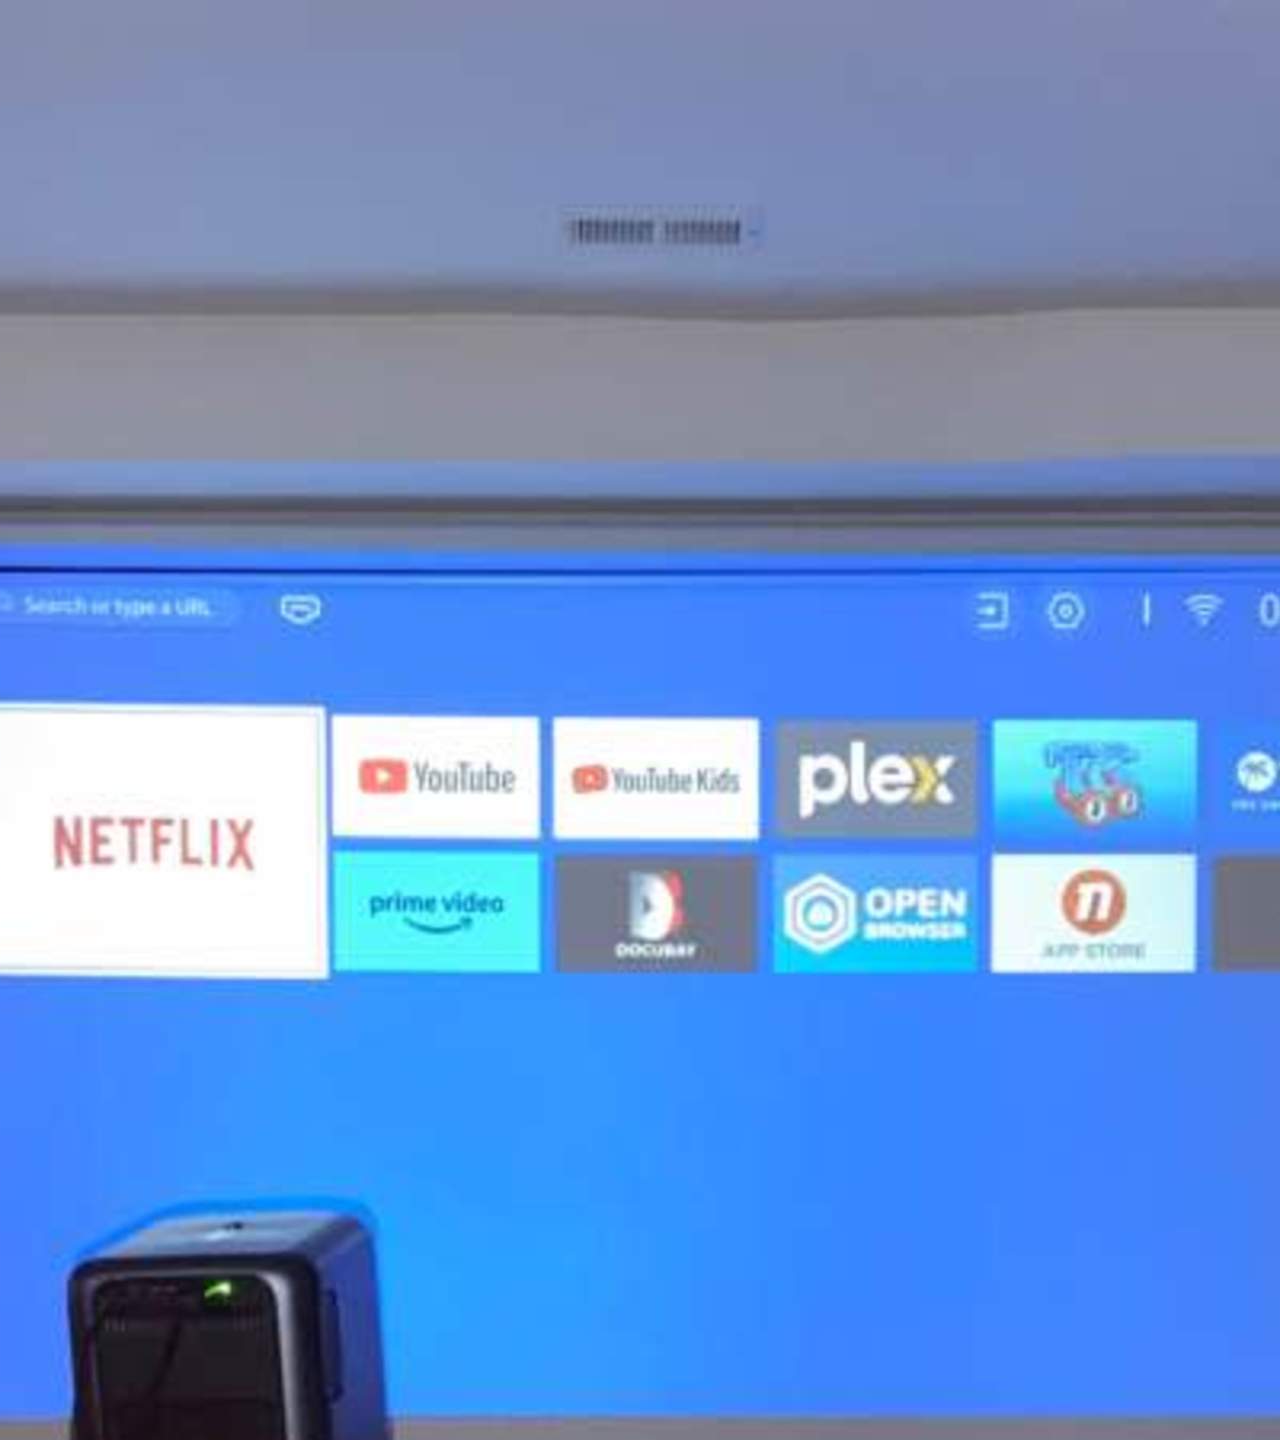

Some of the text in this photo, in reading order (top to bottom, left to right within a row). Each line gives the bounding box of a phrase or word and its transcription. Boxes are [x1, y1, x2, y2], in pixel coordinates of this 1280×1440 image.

[24, 595, 84, 617] Search
[114, 598, 154, 620] type
[176, 597, 211, 617] URL
[414, 762, 517, 794] YouTube
[613, 767, 741, 793] YouTube Kids
[798, 741, 956, 818] plex
[54, 815, 255, 871] NETFLIX
[368, 890, 505, 919] prime video
[865, 889, 968, 918] OPEN
[863, 922, 967, 940] BROWSER
[1042, 943, 1145, 959] APP STORE
